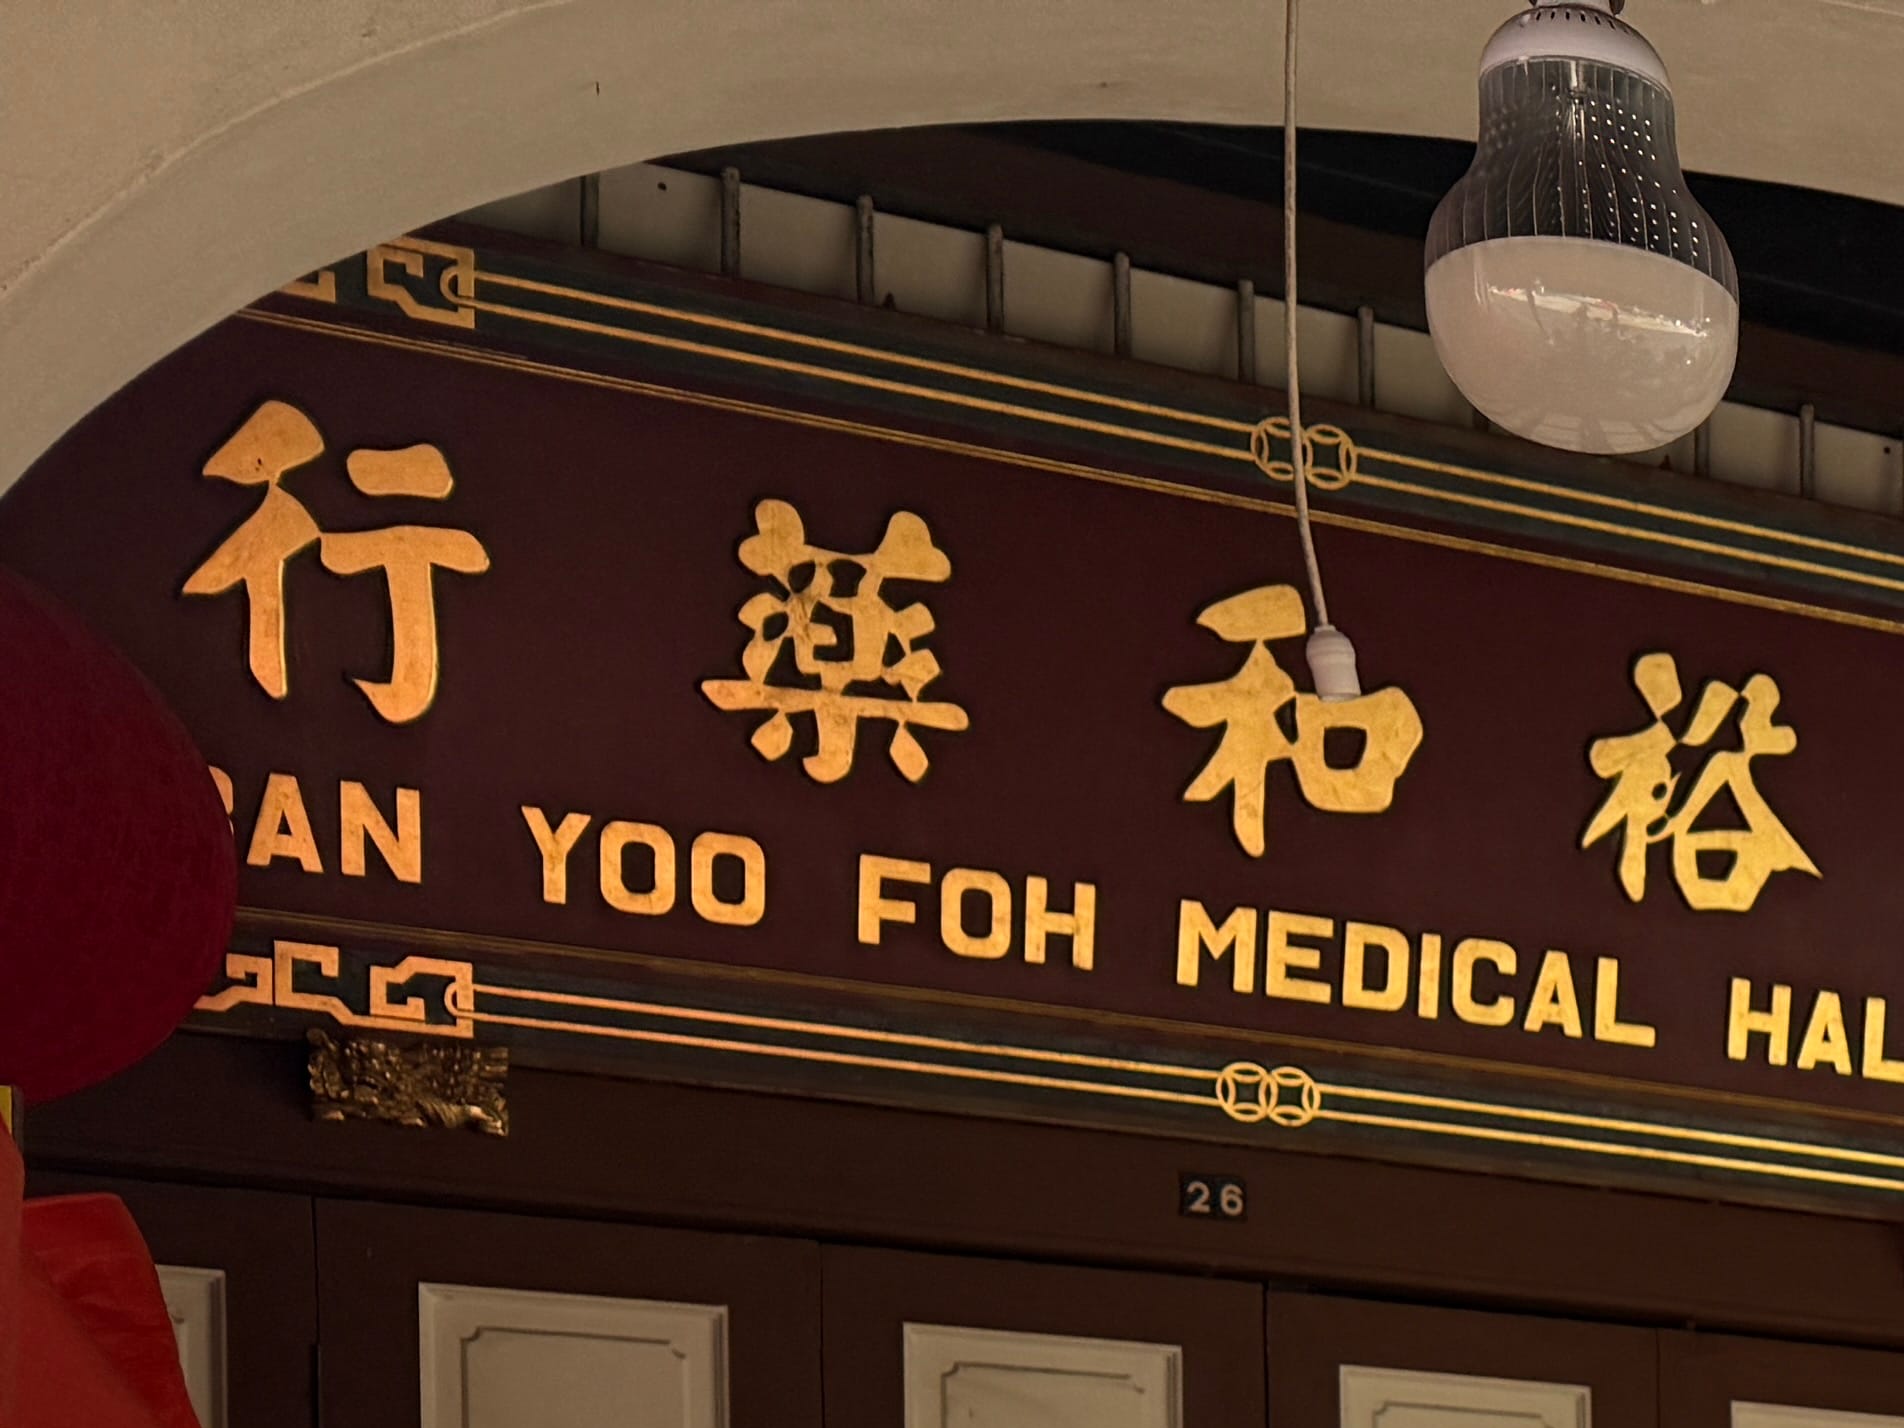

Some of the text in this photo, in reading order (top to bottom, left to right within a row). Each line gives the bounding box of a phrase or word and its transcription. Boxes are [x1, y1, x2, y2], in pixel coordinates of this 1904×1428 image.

[521, 805, 768, 928] YOO
[856, 852, 1098, 973] FOH
[1176, 898, 1658, 1049] MEDICAL
[1185, 1180, 1245, 1217] 26
